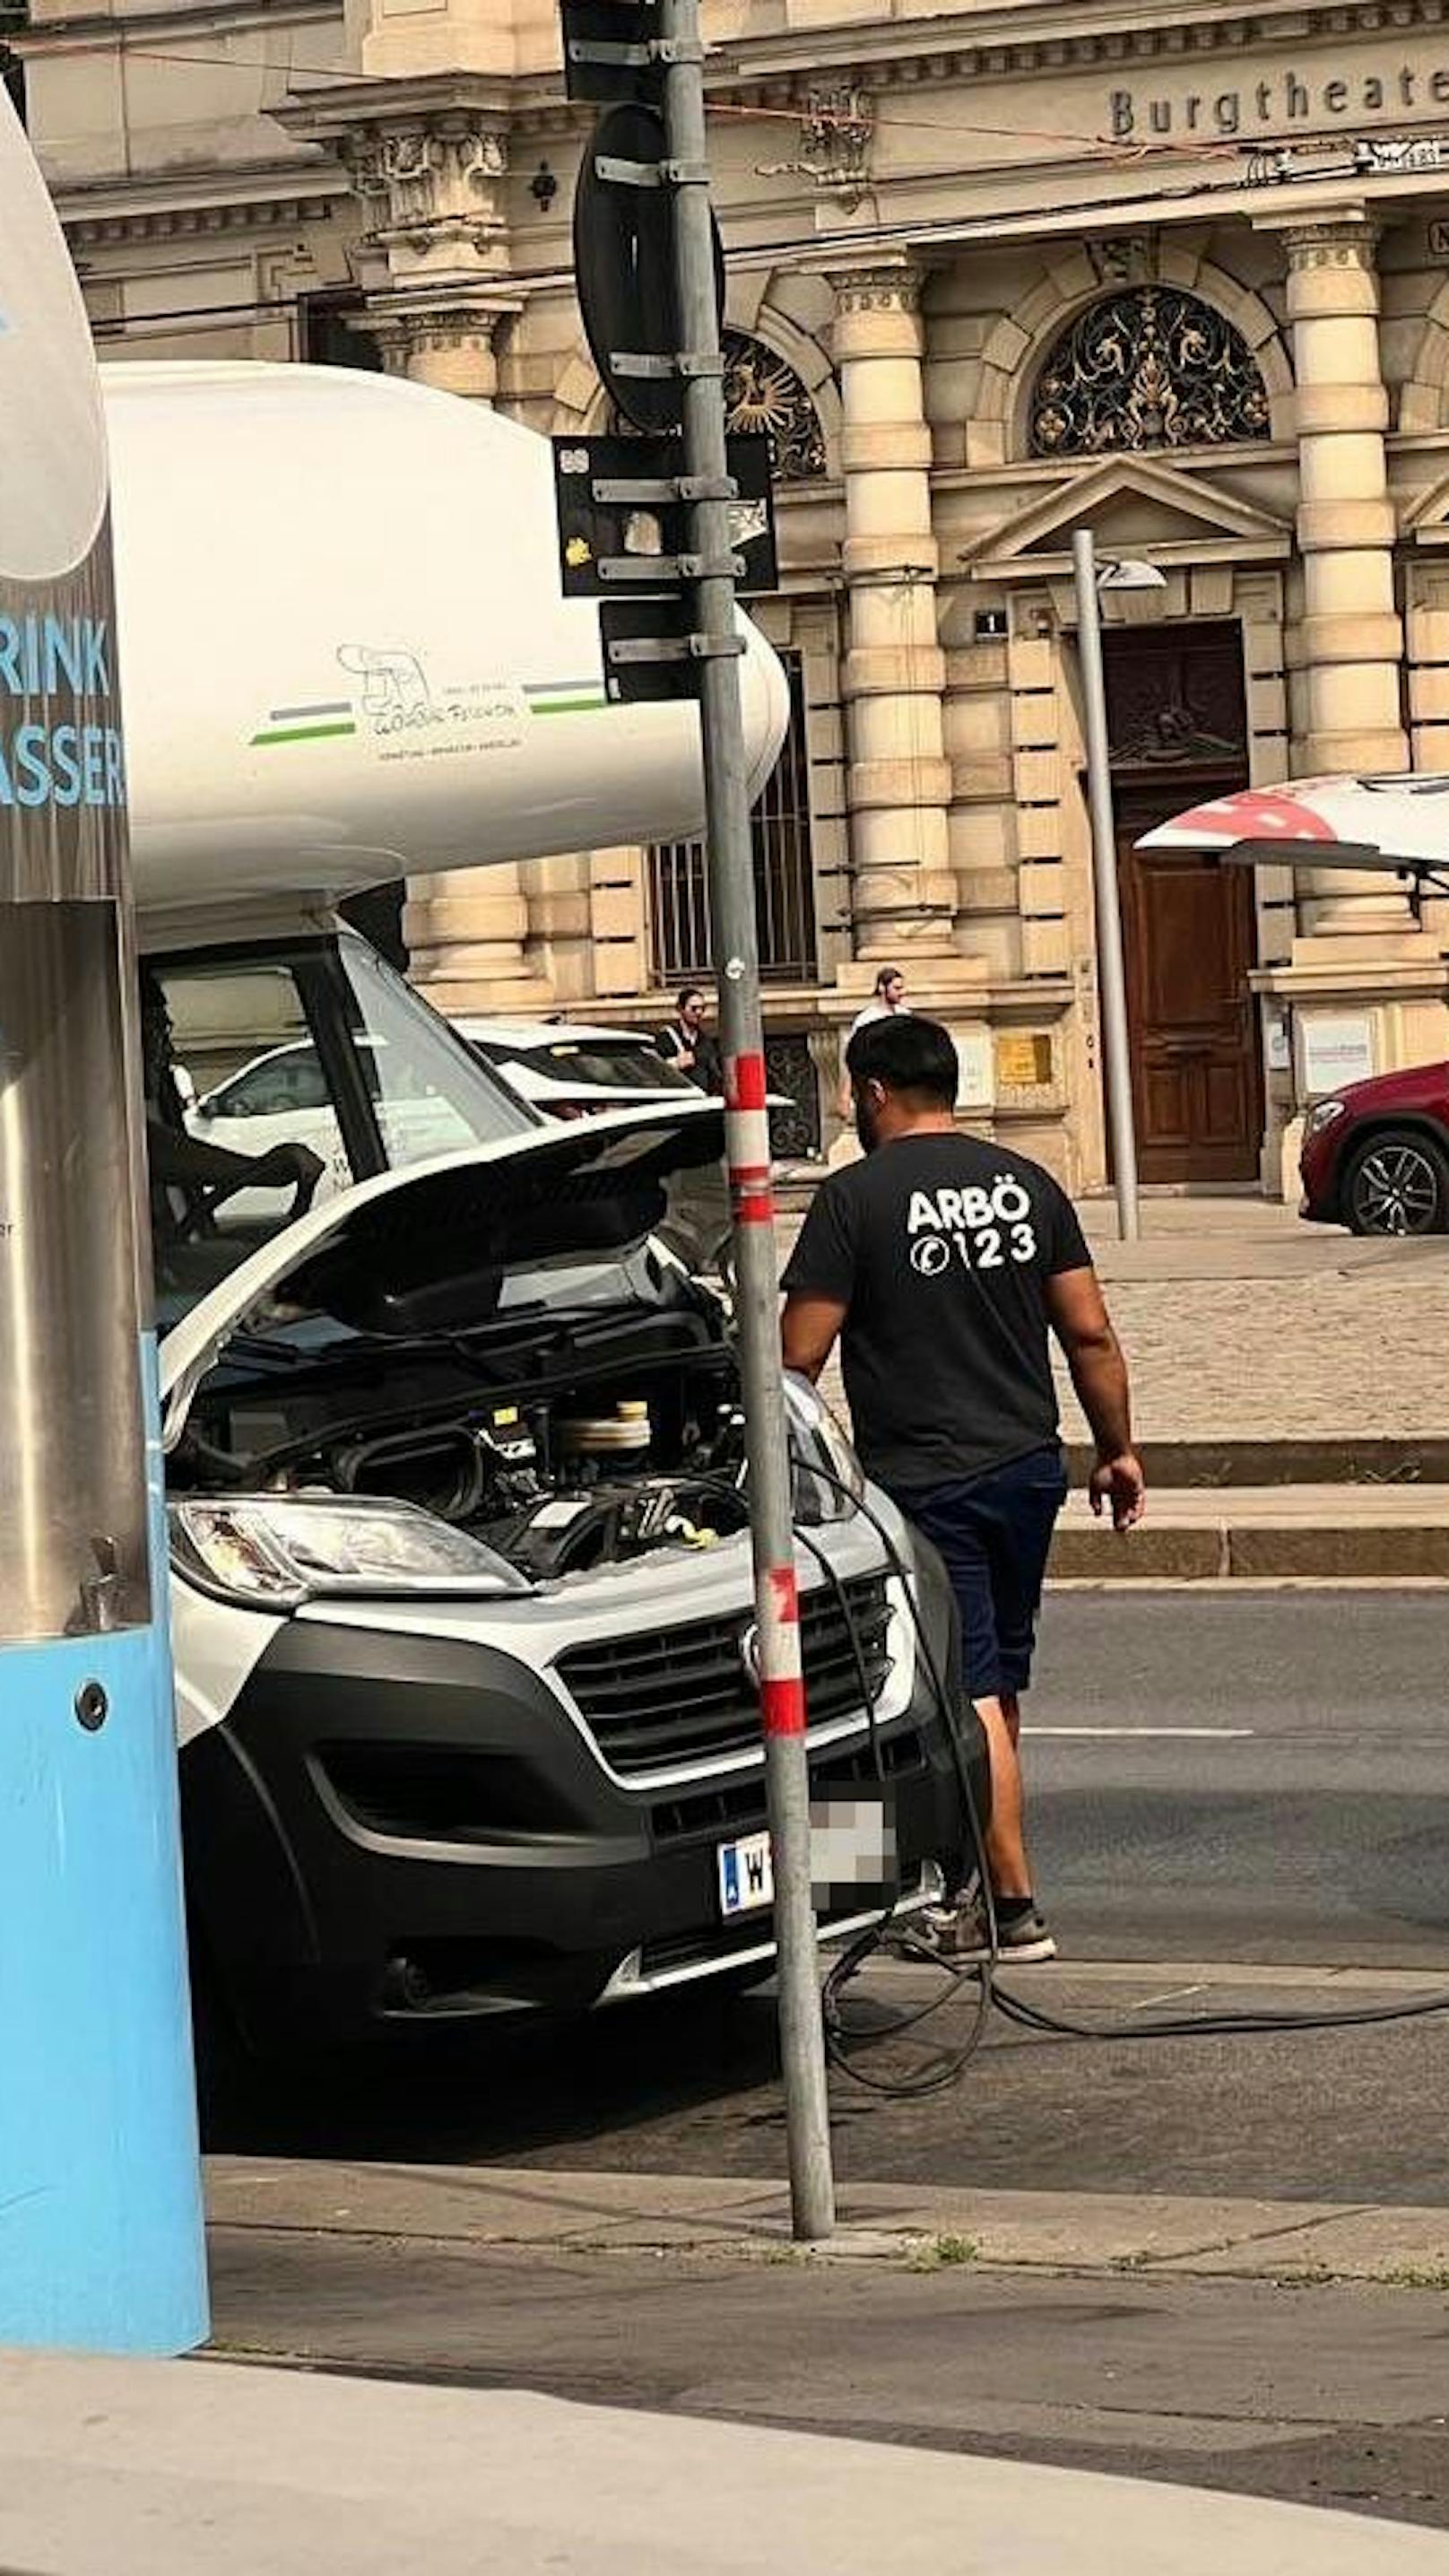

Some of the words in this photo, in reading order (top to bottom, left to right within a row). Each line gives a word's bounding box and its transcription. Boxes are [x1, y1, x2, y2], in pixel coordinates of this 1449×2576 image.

[987, 614, 995, 632] 1
[907, 1172, 1030, 1234] ARBÖ
[745, 1849, 763, 1893] W
